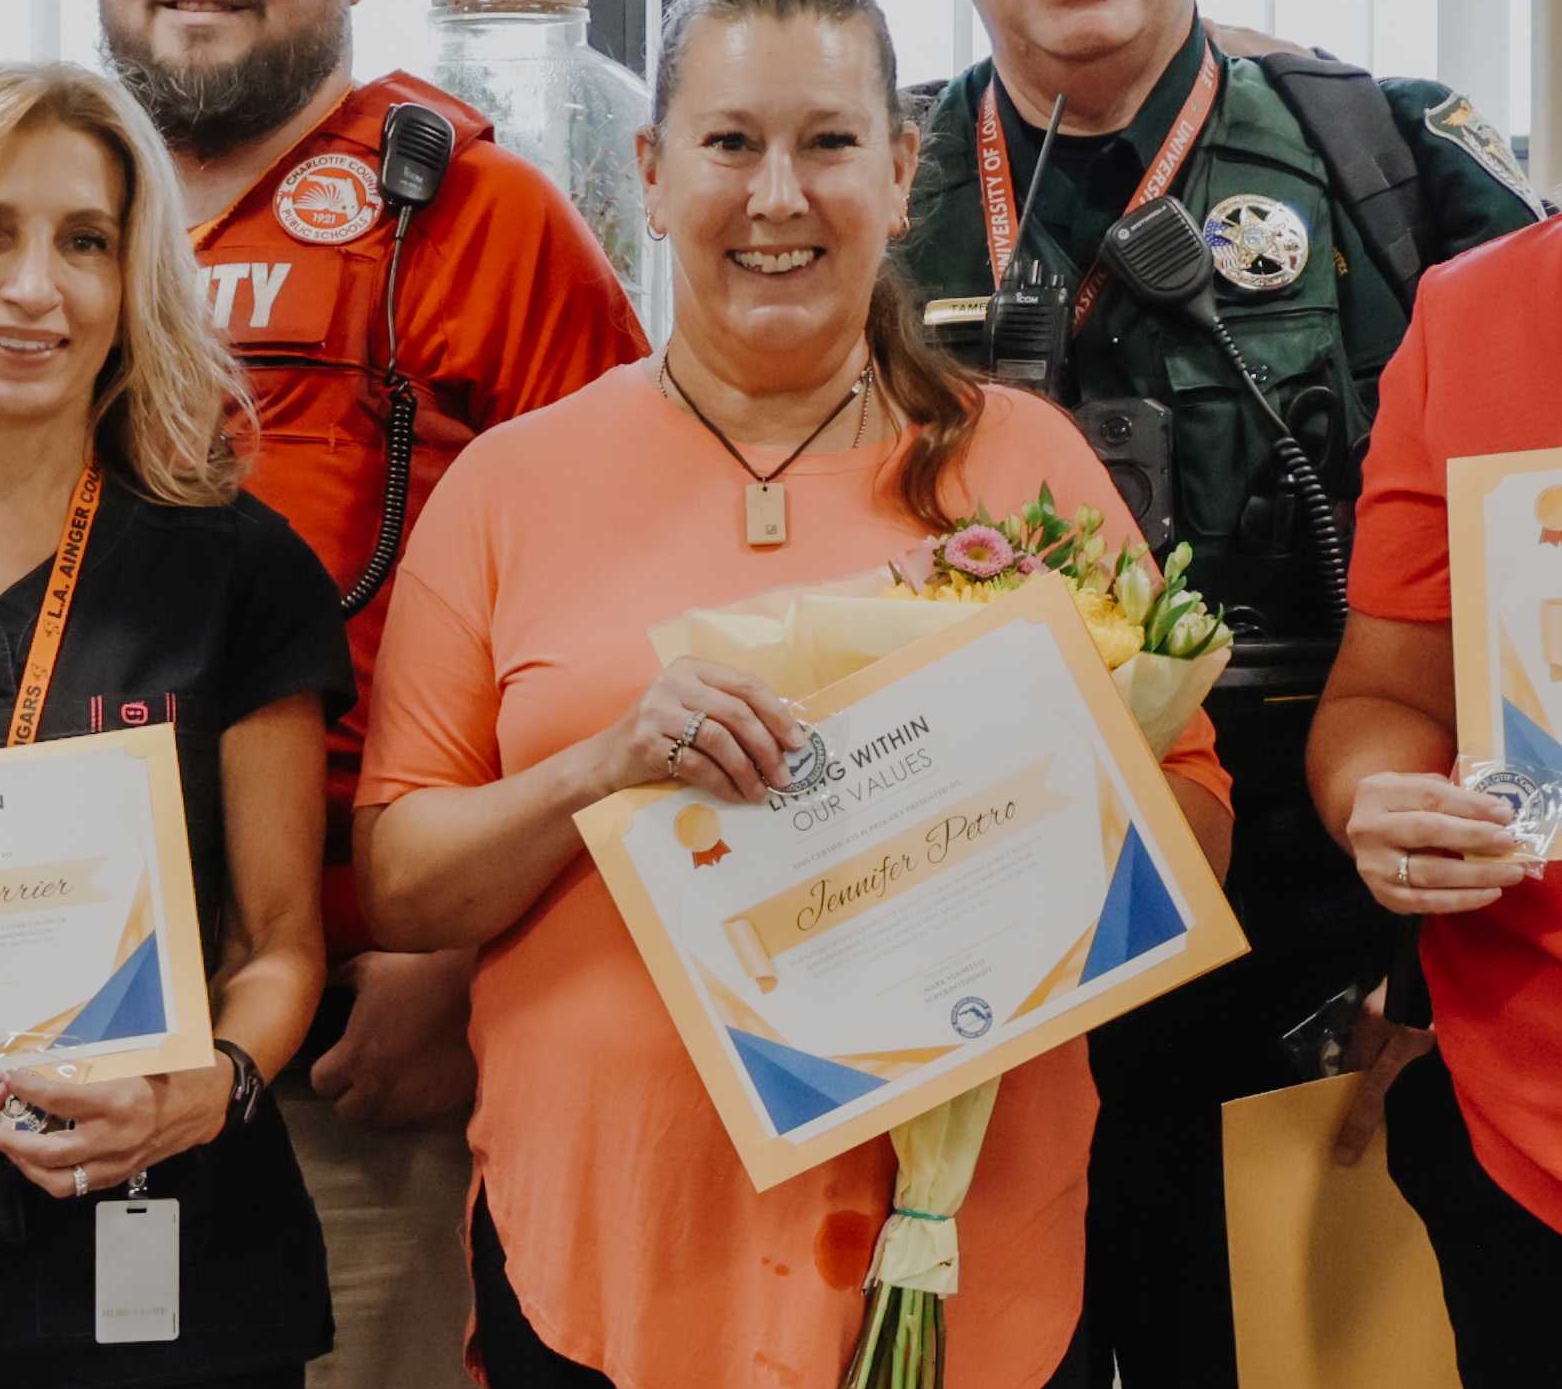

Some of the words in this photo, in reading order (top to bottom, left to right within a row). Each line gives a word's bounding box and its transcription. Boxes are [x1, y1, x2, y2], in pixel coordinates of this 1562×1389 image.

[983, 144, 1001, 169] OF
[47, 584, 70, 620] L.A.
[59, 505, 90, 578] AINGER
[849, 715, 930, 768] WITHIN
[793, 795, 845, 831] OUR
[846, 748, 932, 801] VALUES
[796, 854, 918, 931] Jennifer
[925, 801, 1017, 863] Petro
